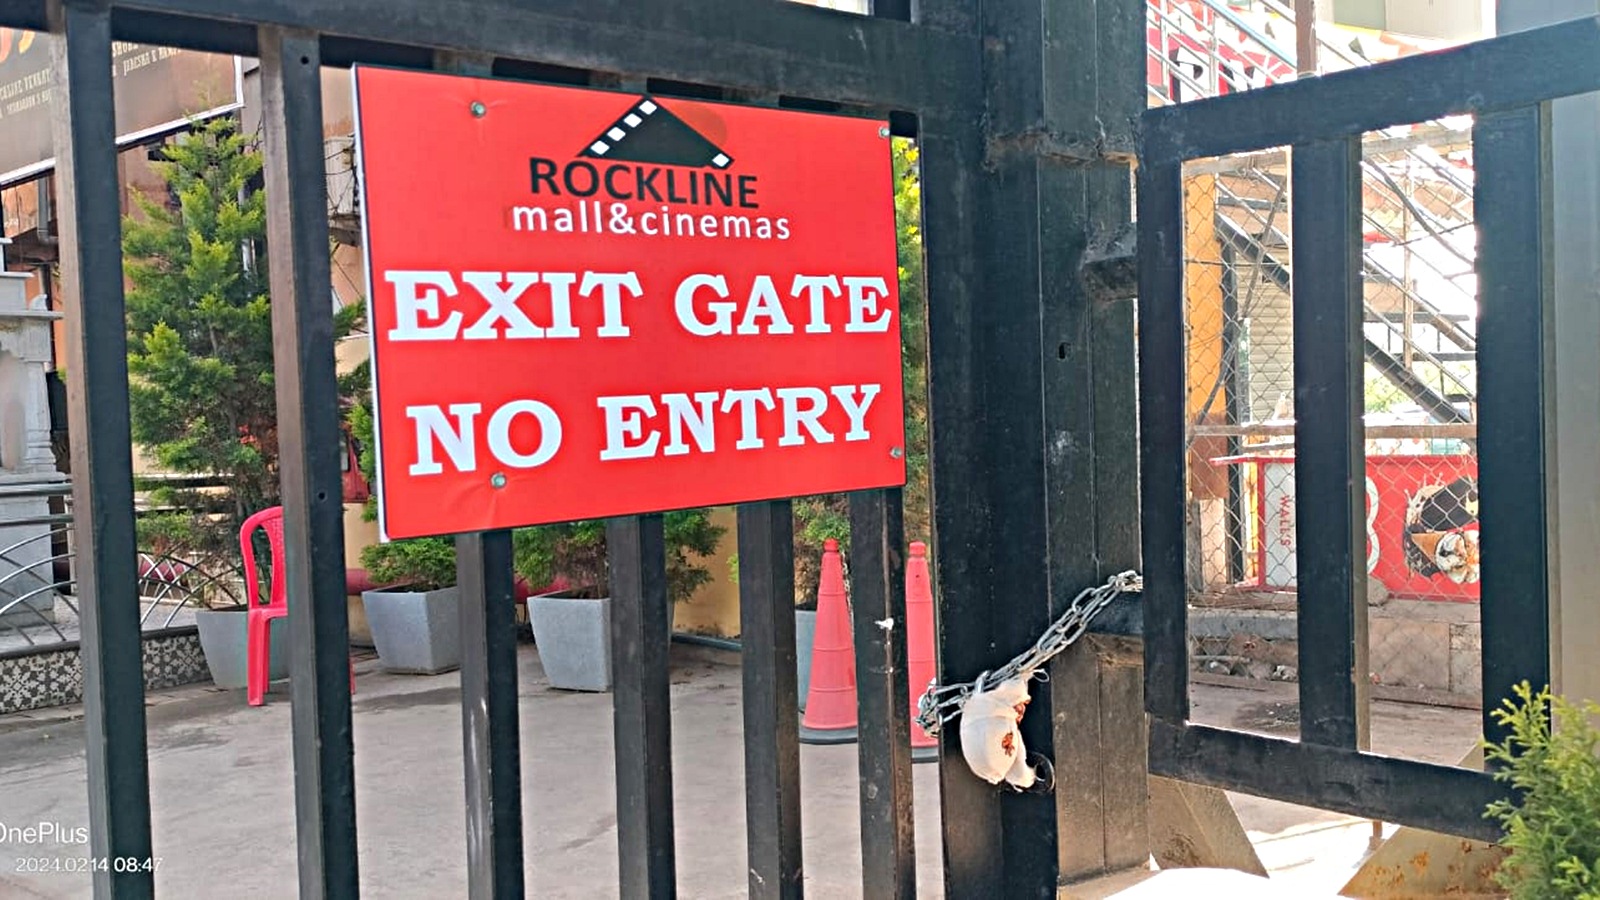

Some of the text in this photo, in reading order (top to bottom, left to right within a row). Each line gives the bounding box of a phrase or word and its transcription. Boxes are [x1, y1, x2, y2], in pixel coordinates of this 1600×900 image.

[530, 157, 758, 209] ROCKLINE
[513, 200, 790, 240] mall&cinemas
[384, 270, 892, 341] EXIT GATE
[406, 384, 881, 476] NO ENTRY
